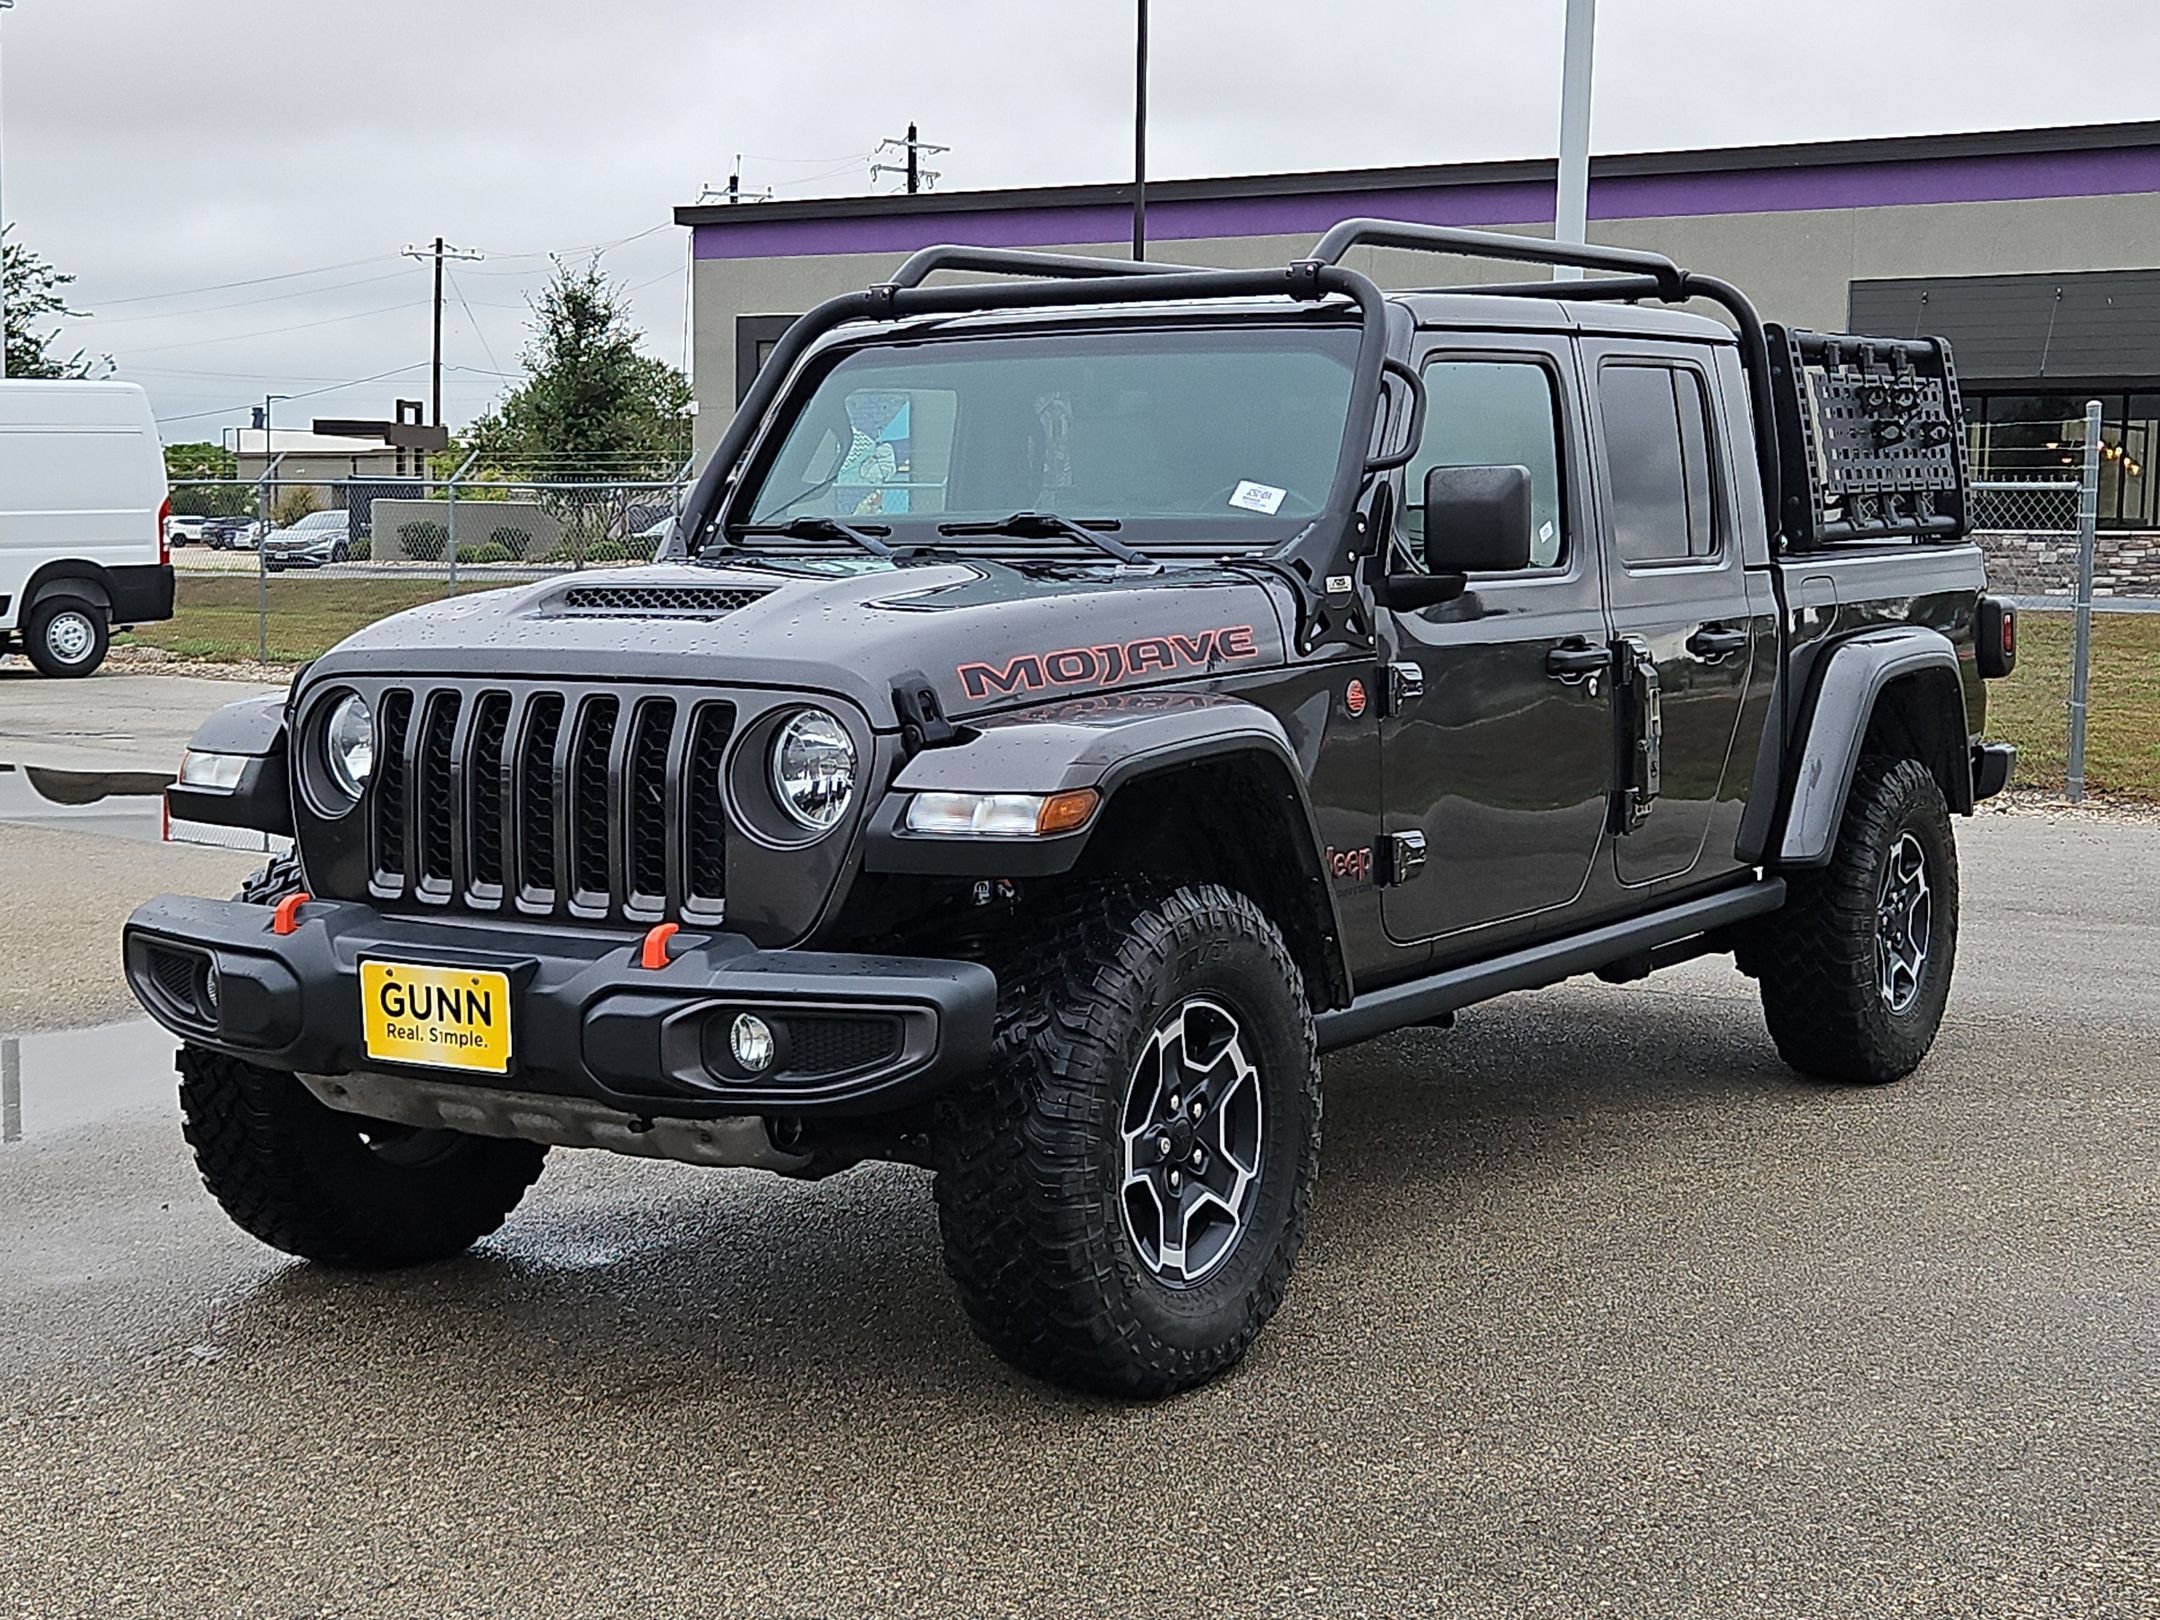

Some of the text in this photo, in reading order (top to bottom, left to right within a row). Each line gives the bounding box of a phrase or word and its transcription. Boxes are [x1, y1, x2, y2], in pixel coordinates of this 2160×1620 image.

[958, 626, 1257, 699] MOJAVE
[1325, 845, 1373, 880] Jeep
[380, 982, 492, 1027] GUNN
[387, 1023, 424, 1042] Real.
